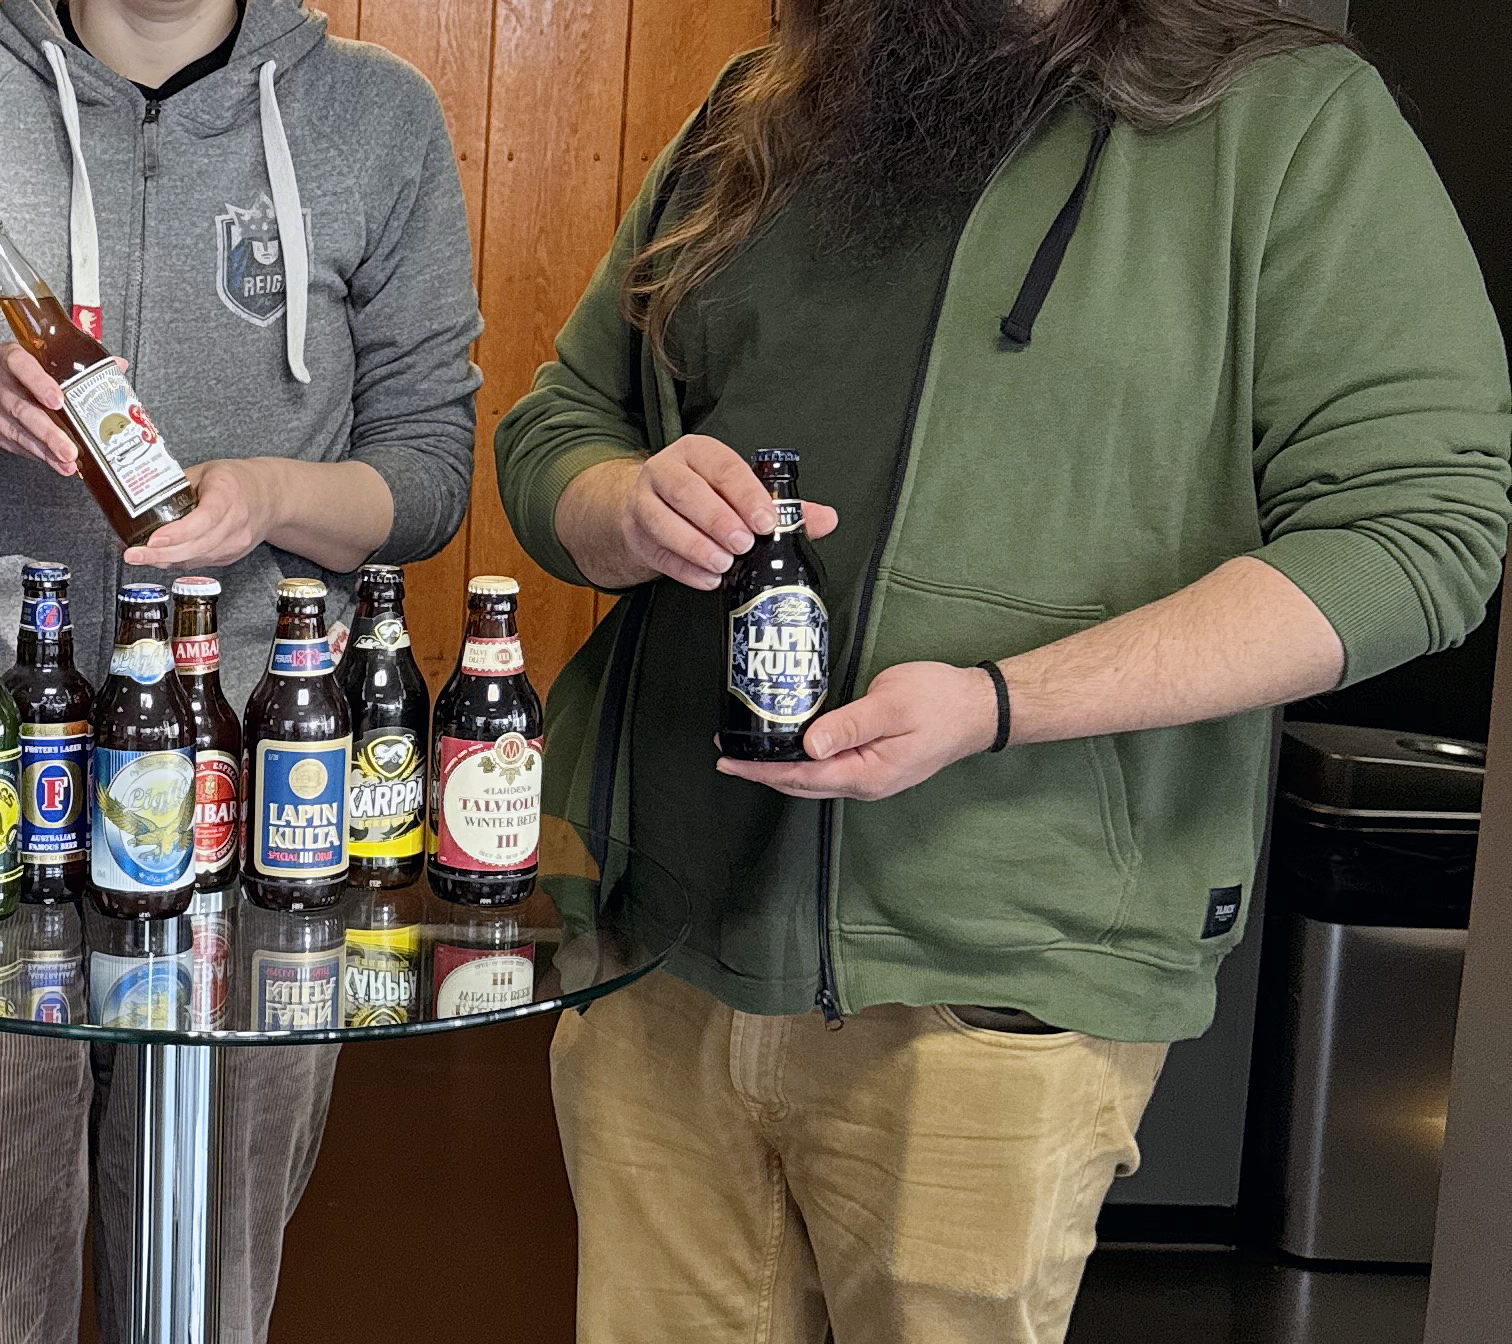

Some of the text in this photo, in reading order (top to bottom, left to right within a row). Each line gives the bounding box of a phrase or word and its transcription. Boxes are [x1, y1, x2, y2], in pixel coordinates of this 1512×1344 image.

[244, 275, 286, 297] REIG
[748, 626, 820, 650] LAPIN
[748, 651, 821, 680] KULTA
[771, 675, 805, 683] TALVI
[41, 776, 68, 811] F
[123, 777, 189, 815] Light
[350, 777, 424, 818] KÄRPPÄ
[491, 785, 526, 795] LAHDEN
[269, 802, 338, 826] LAPIN
[459, 793, 540, 812] TALVIOLUT
[464, 813, 538, 828] WINTER BEER
[269, 825, 340, 849] KULTA
[496, 833, 519, 848] III
[299, 851, 313, 864] III
